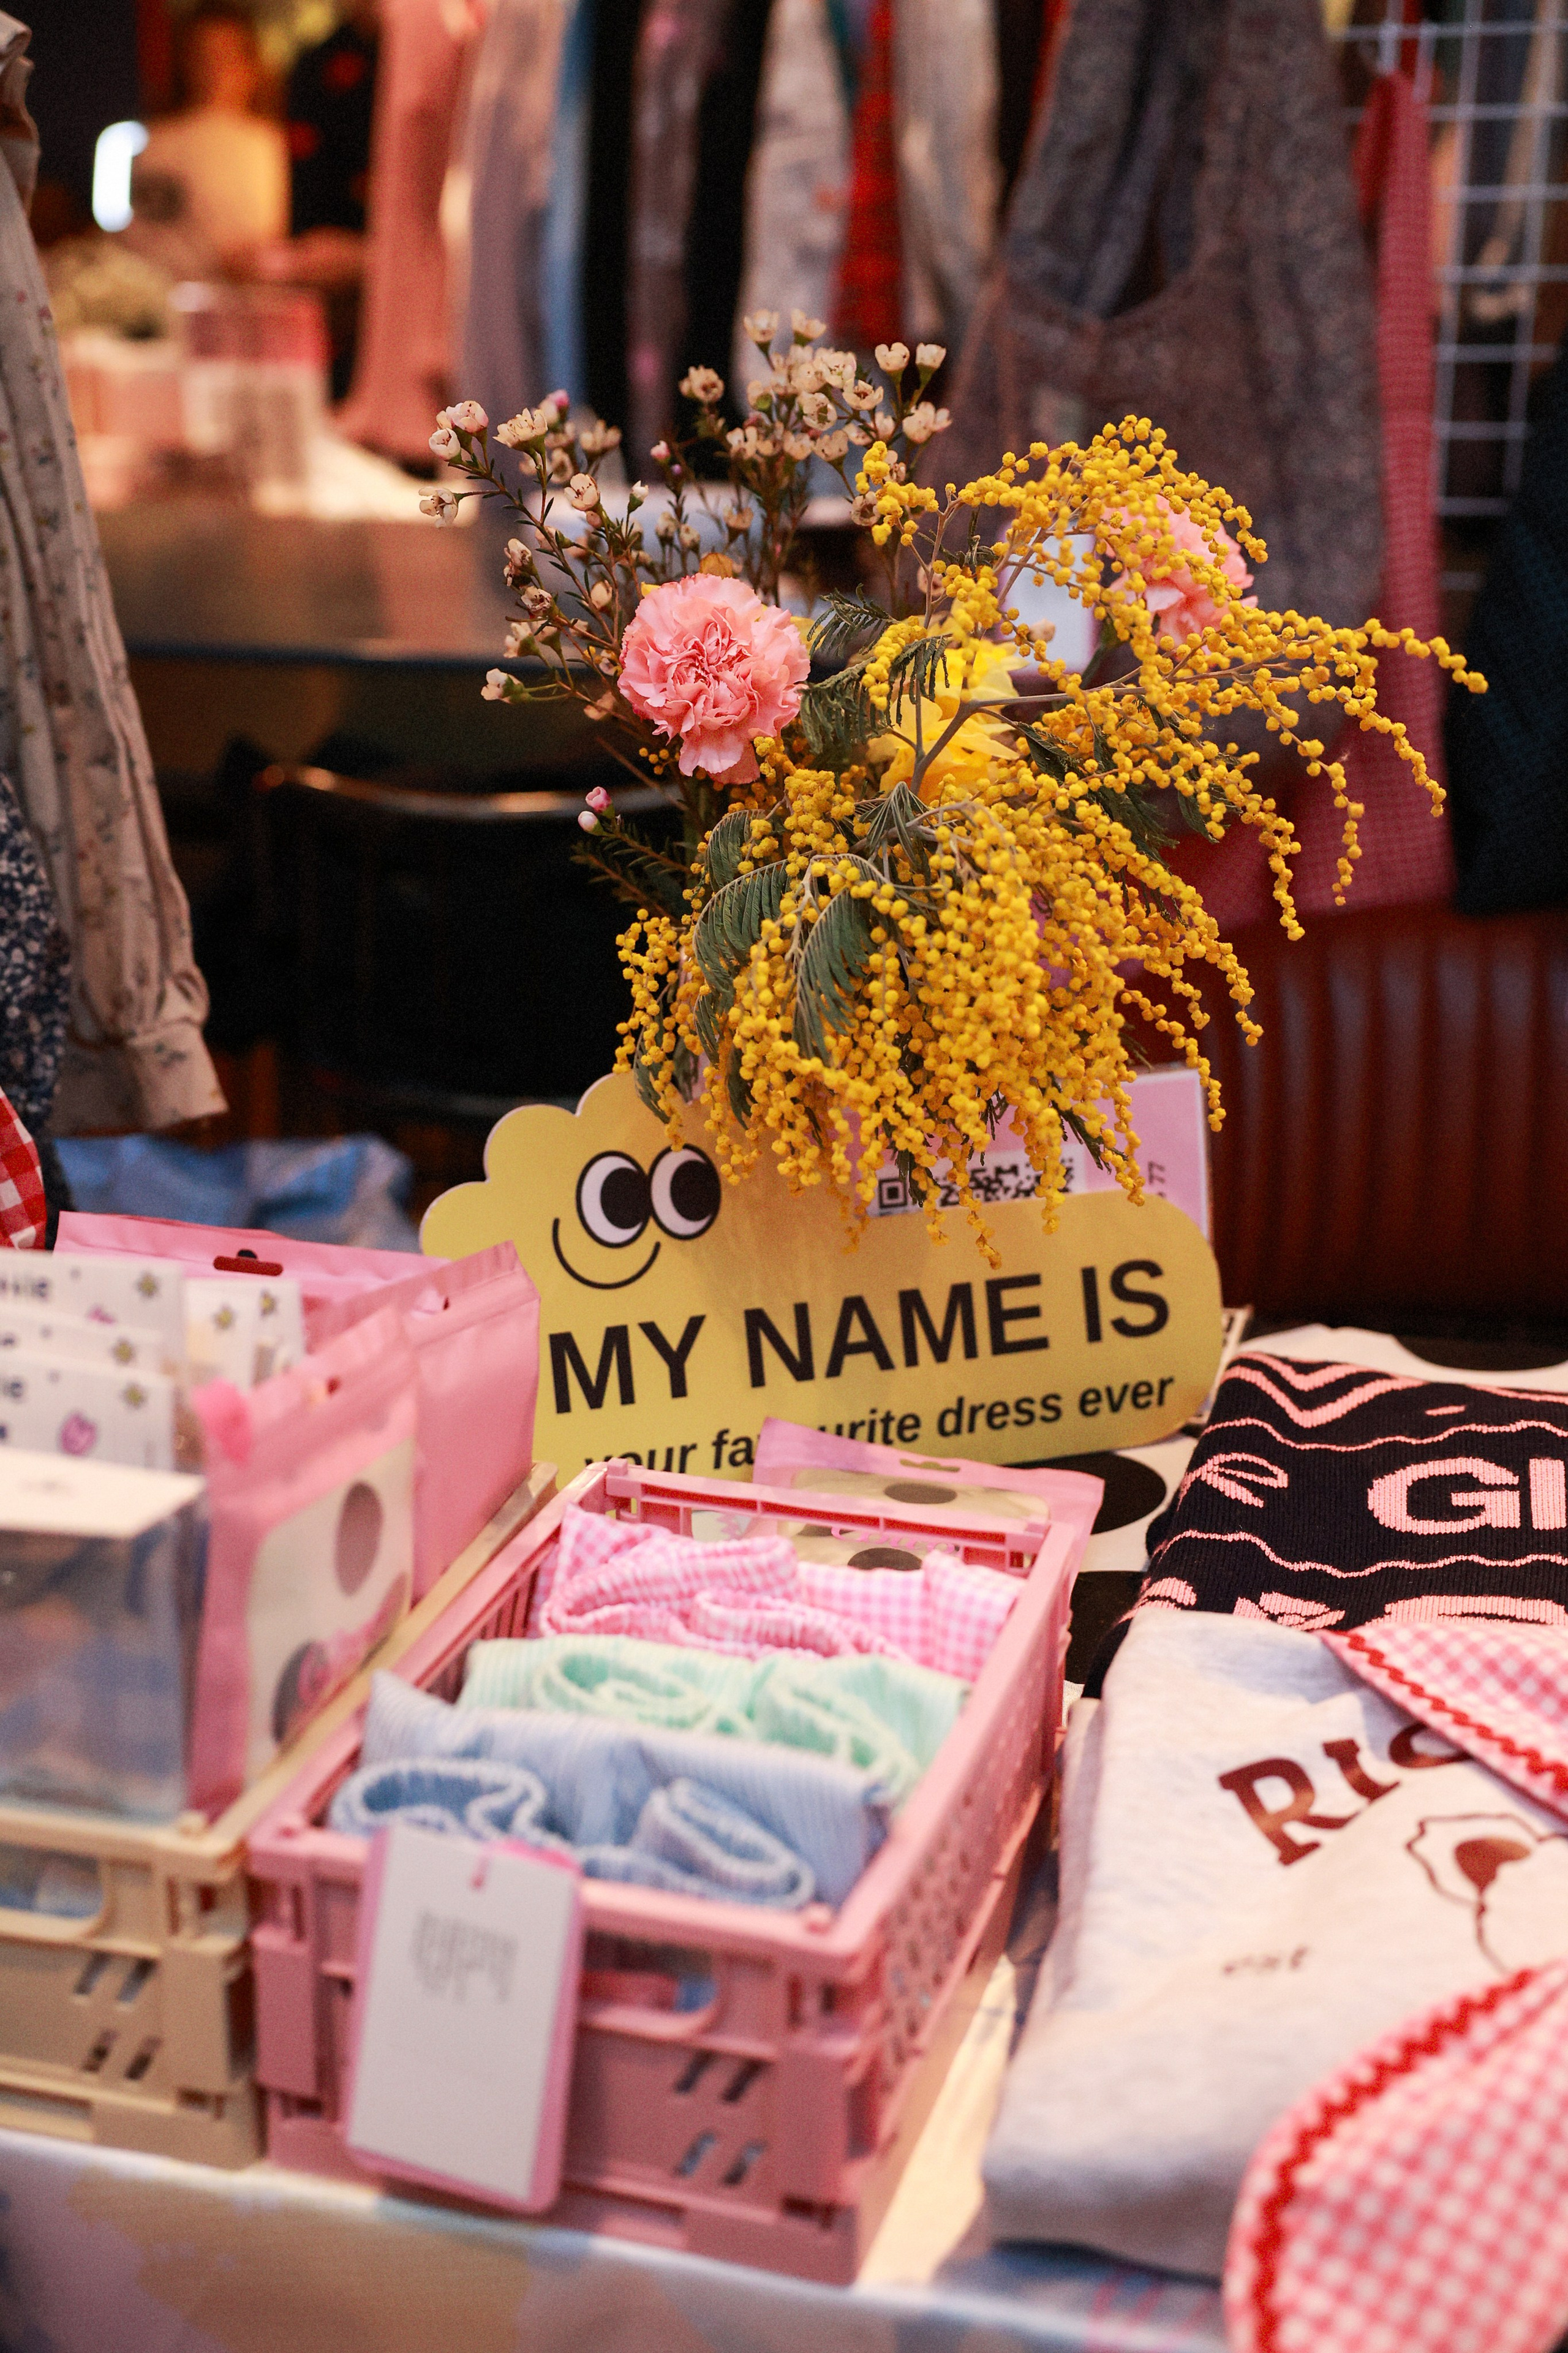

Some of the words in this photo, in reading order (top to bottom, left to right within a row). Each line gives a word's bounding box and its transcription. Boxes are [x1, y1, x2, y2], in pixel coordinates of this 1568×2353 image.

[548, 1313, 707, 1414] MY
[743, 1272, 1050, 1389] NAME
[1080, 1258, 1170, 1342] IS
[584, 1443, 698, 1474] ur
[711, 1407, 922, 1470] farite
[937, 1393, 1063, 1438] dress
[1079, 1375, 1174, 1416] ever
